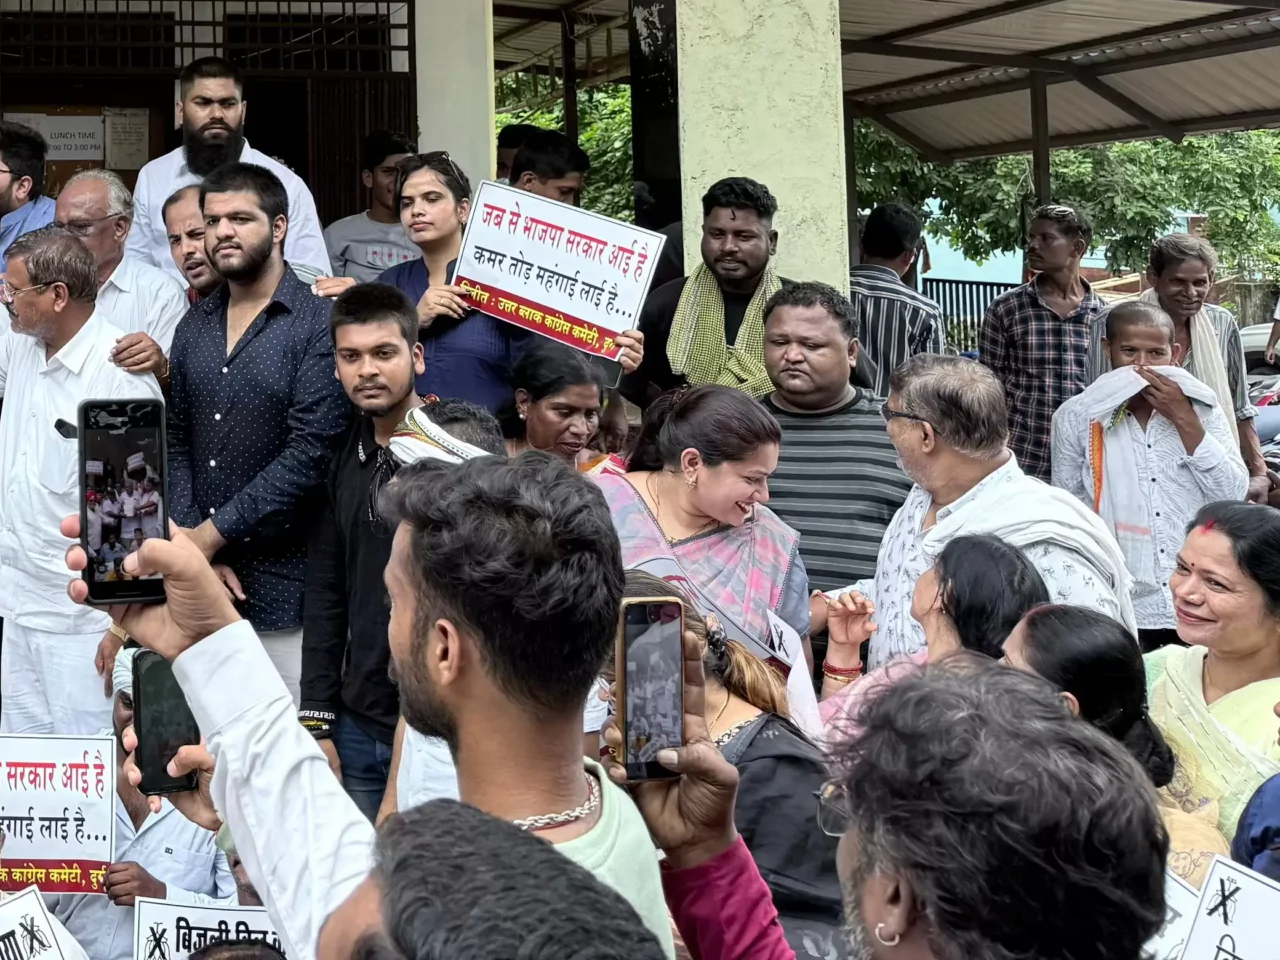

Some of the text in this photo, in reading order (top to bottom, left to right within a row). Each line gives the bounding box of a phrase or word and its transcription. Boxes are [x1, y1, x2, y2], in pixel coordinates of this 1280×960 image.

[482, 201, 648, 282] जब से भाजपा सरकार आई है
[473, 245, 507, 272] कमर
[508, 250, 534, 285] तोड़
[536, 264, 581, 301] महंगाई
[579, 279, 608, 311] लाई
[497, 297, 517, 315] उत्तर
[518, 305, 544, 324] ब्लाक
[544, 312, 572, 334] कांग्रेस
[6, 760, 56, 792] सरकार
[62, 750, 89, 798] आई
[93, 749, 105, 799] है
[38, 807, 70, 844] लाई
[11, 863, 47, 884] कांग्रेस
